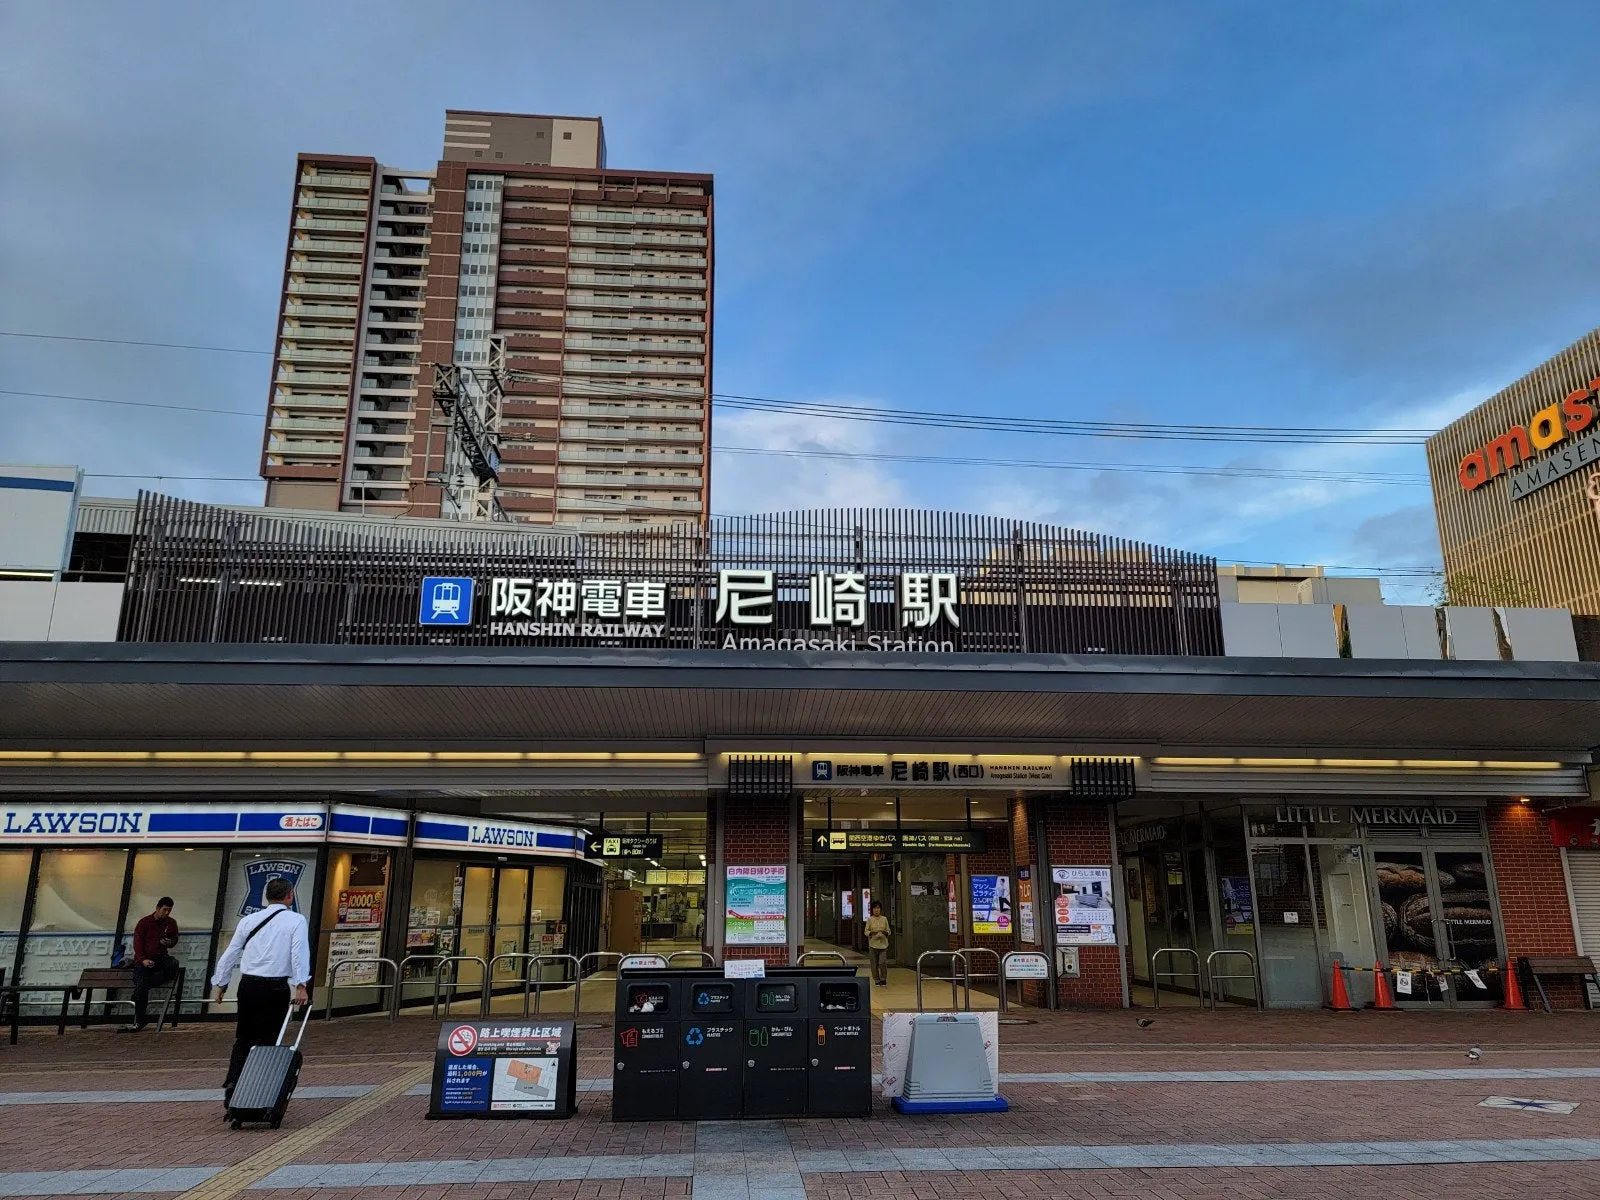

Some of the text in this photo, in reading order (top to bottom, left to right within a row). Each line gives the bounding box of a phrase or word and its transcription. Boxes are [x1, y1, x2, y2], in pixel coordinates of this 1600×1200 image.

[1459, 376, 1600, 491] amas
[490, 578, 667, 618] 阪神電車
[716, 569, 960, 628] 尼崎駅
[490, 622, 665, 638] HANSHIN RAILWAY
[867, 635, 954, 652] Station
[836, 765, 885, 777] 阪神電車
[3, 812, 143, 833] LAWSON
[1275, 806, 1458, 825] LITTLE MERMAID
[471, 825, 535, 847] LAWSON
[249, 862, 300, 875] LAWSON
[728, 867, 785, 875] 白内障日帰り手術
[479, 1026, 563, 1038] 路上喫煙禁止区域
